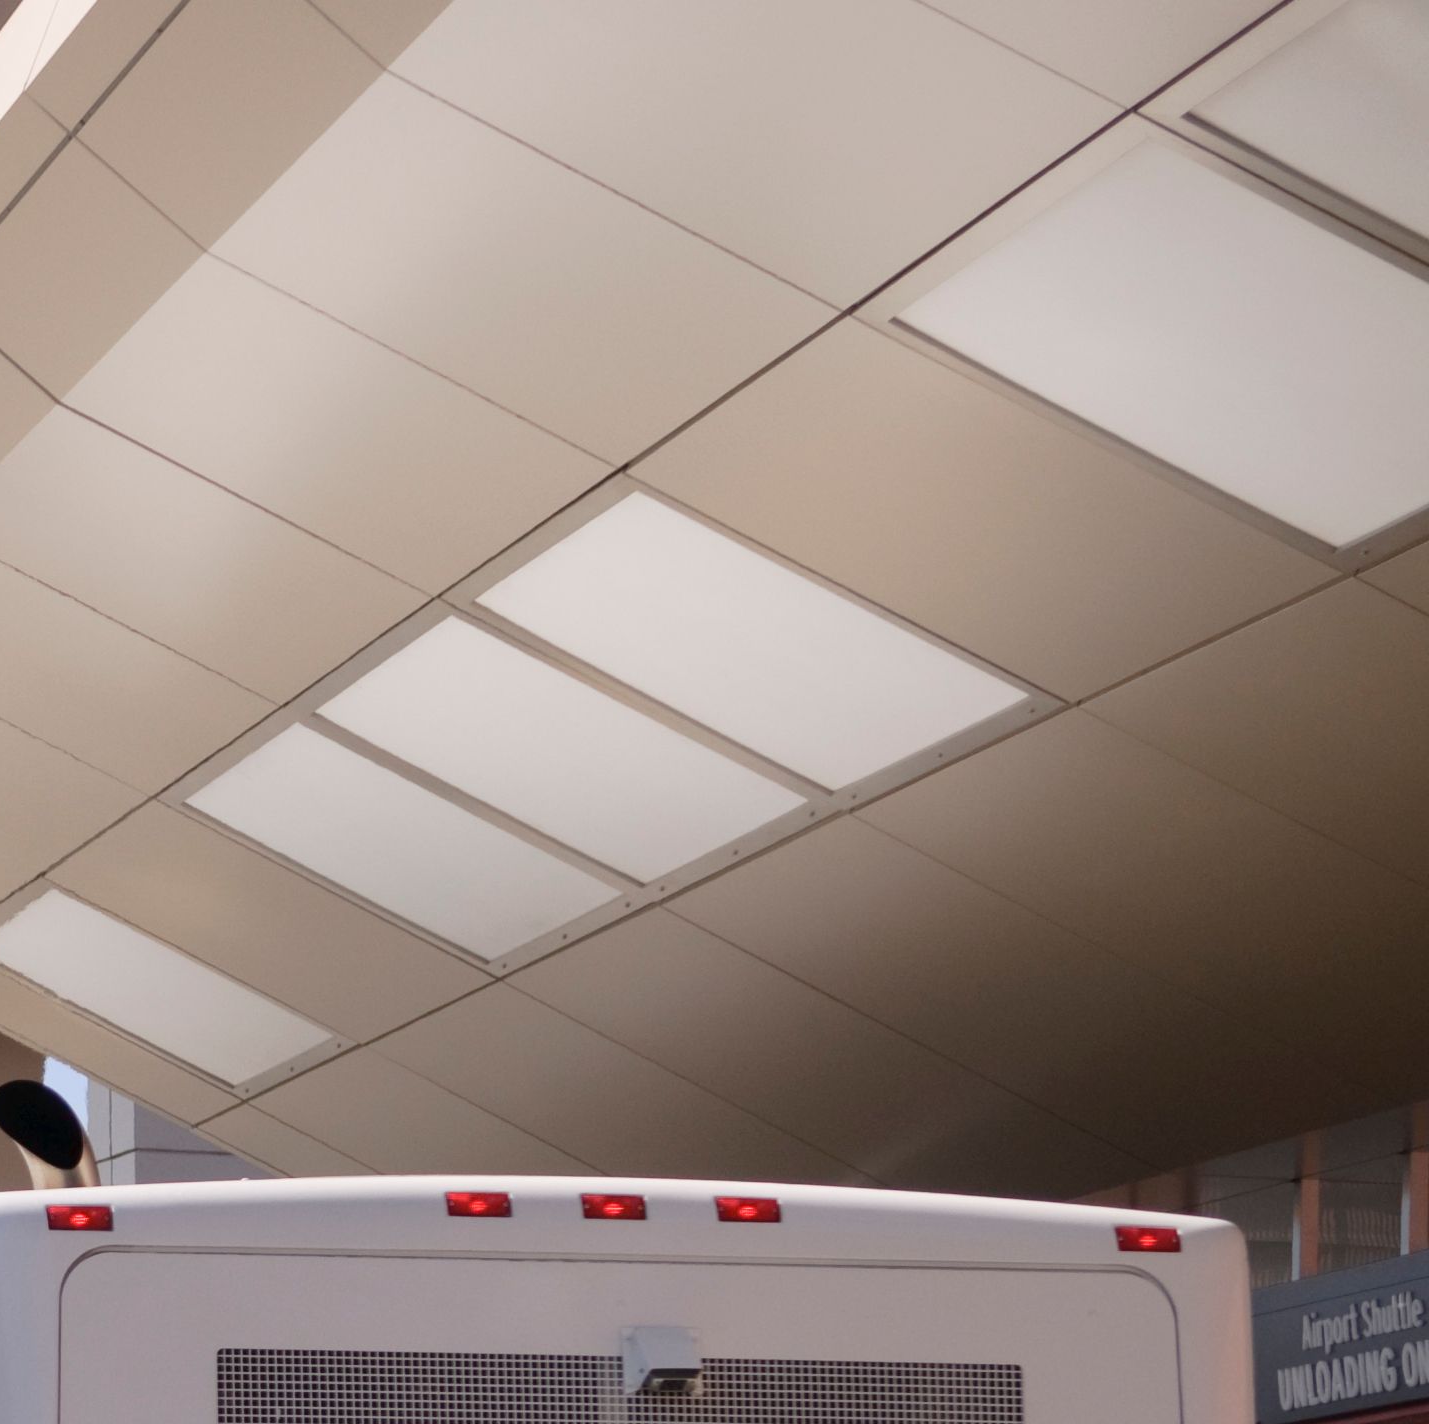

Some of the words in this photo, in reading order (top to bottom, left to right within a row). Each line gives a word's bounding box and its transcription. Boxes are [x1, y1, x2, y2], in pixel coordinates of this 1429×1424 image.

[1302, 1303, 1360, 1354] Airport
[1361, 1291, 1423, 1337] Shuttle
[1277, 1347, 1397, 1410] UNLOADING
